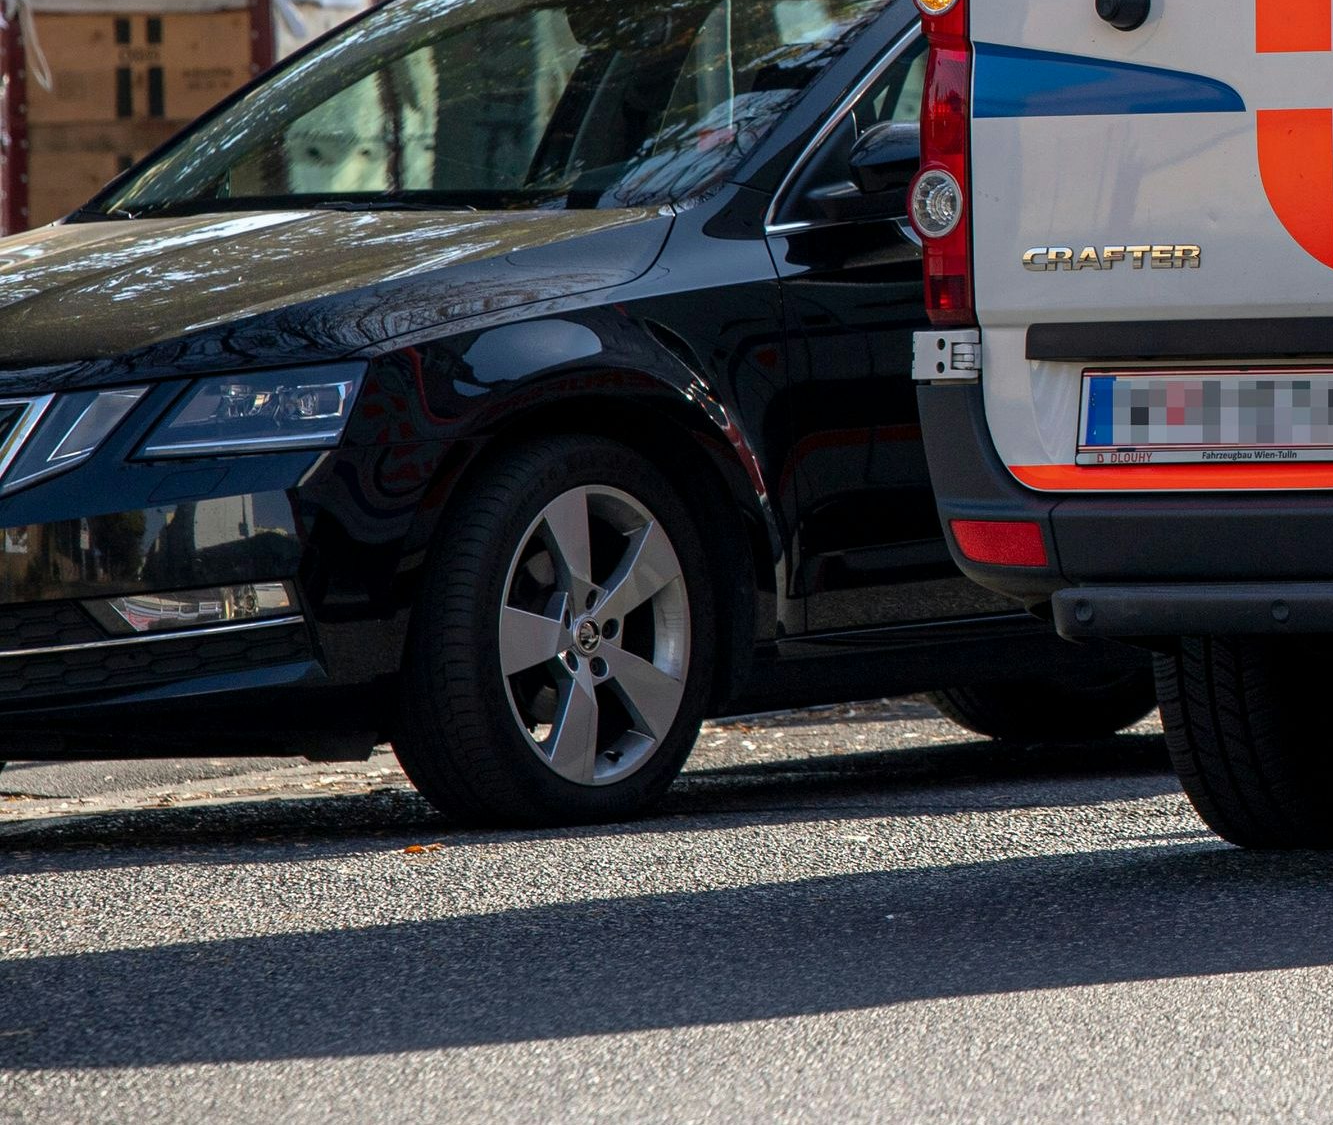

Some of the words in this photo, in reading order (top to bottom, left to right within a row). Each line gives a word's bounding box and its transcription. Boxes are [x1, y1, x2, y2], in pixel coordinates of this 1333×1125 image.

[1022, 244, 1201, 271] CRAFTER
[1111, 452, 1152, 463] DLOUHY
[1202, 451, 1252, 461] Fahrzeugbau
[1254, 450, 1297, 459] Wien-Tulln
